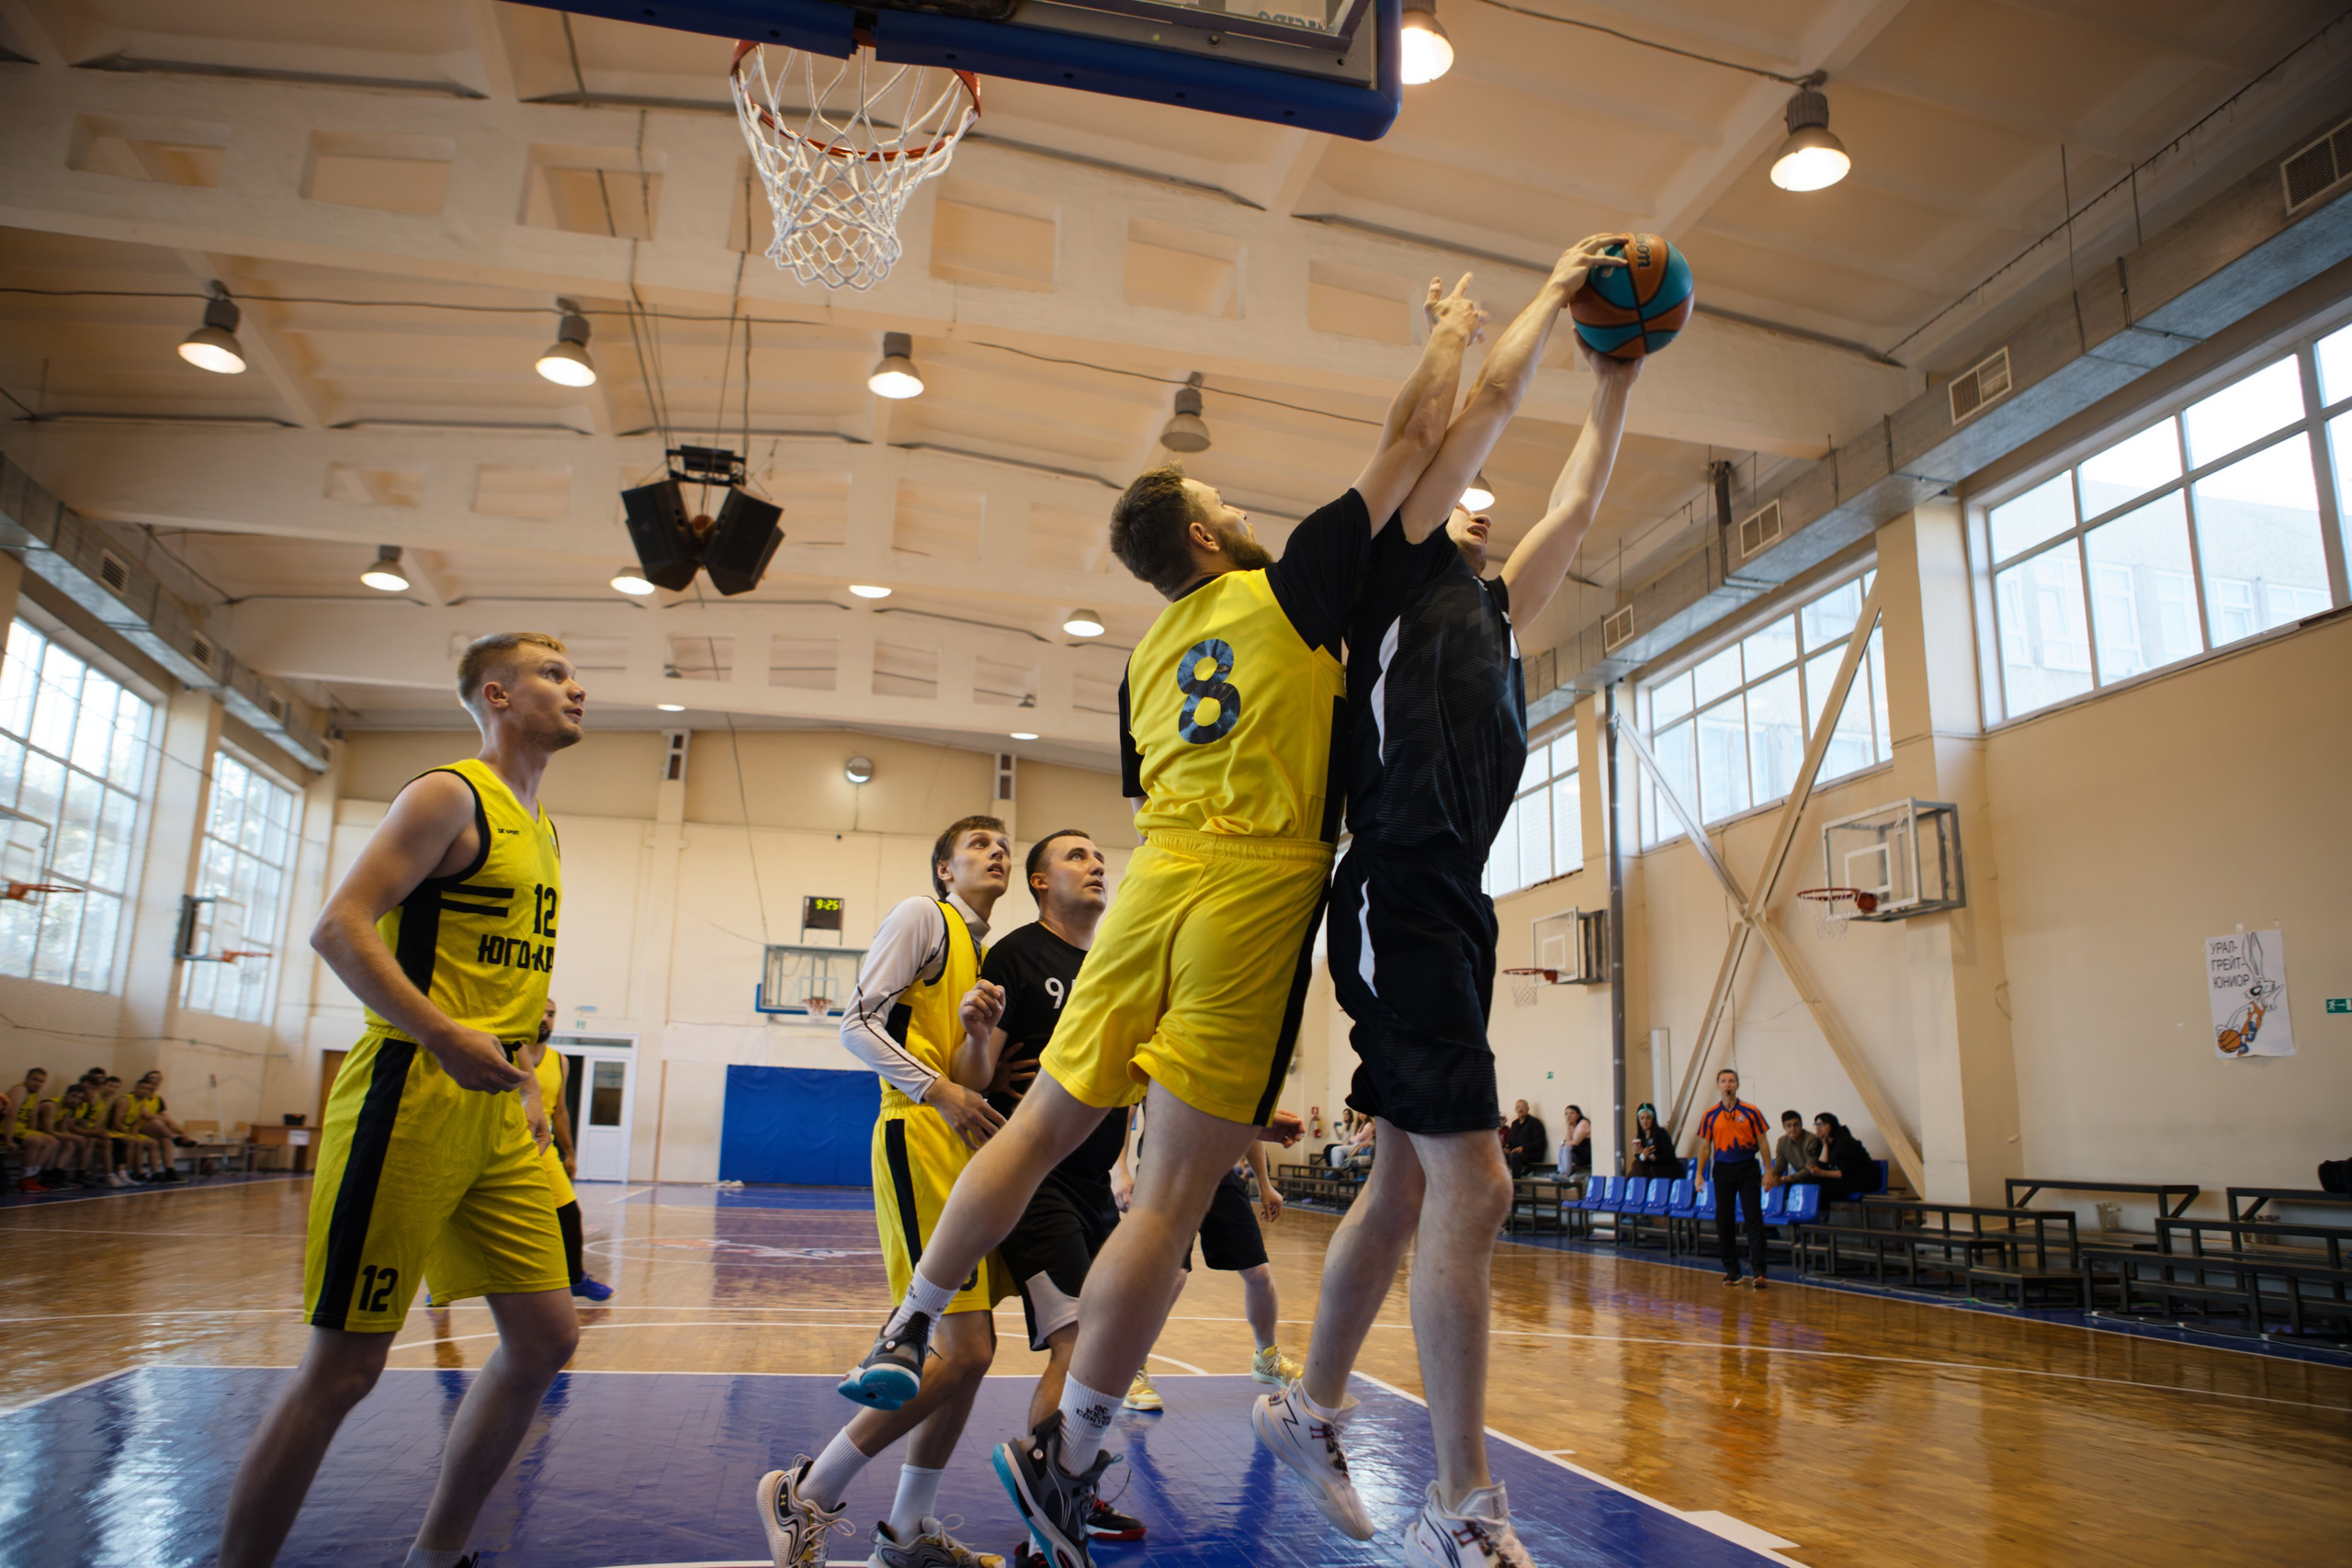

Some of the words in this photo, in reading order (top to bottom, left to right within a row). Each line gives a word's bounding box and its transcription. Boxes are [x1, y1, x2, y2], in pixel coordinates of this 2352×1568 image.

[1177, 638, 1241, 745] 8
[533, 883, 557, 938] 12
[816, 898, 839, 910] 9:25
[2210, 941, 2238, 955] УРАЛ-
[2211, 955, 2245, 972] ГРЕЙТ-
[1045, 976, 1076, 1009] 9
[2213, 974, 2250, 989] ЮНИОР
[358, 1264, 399, 1312] 12
